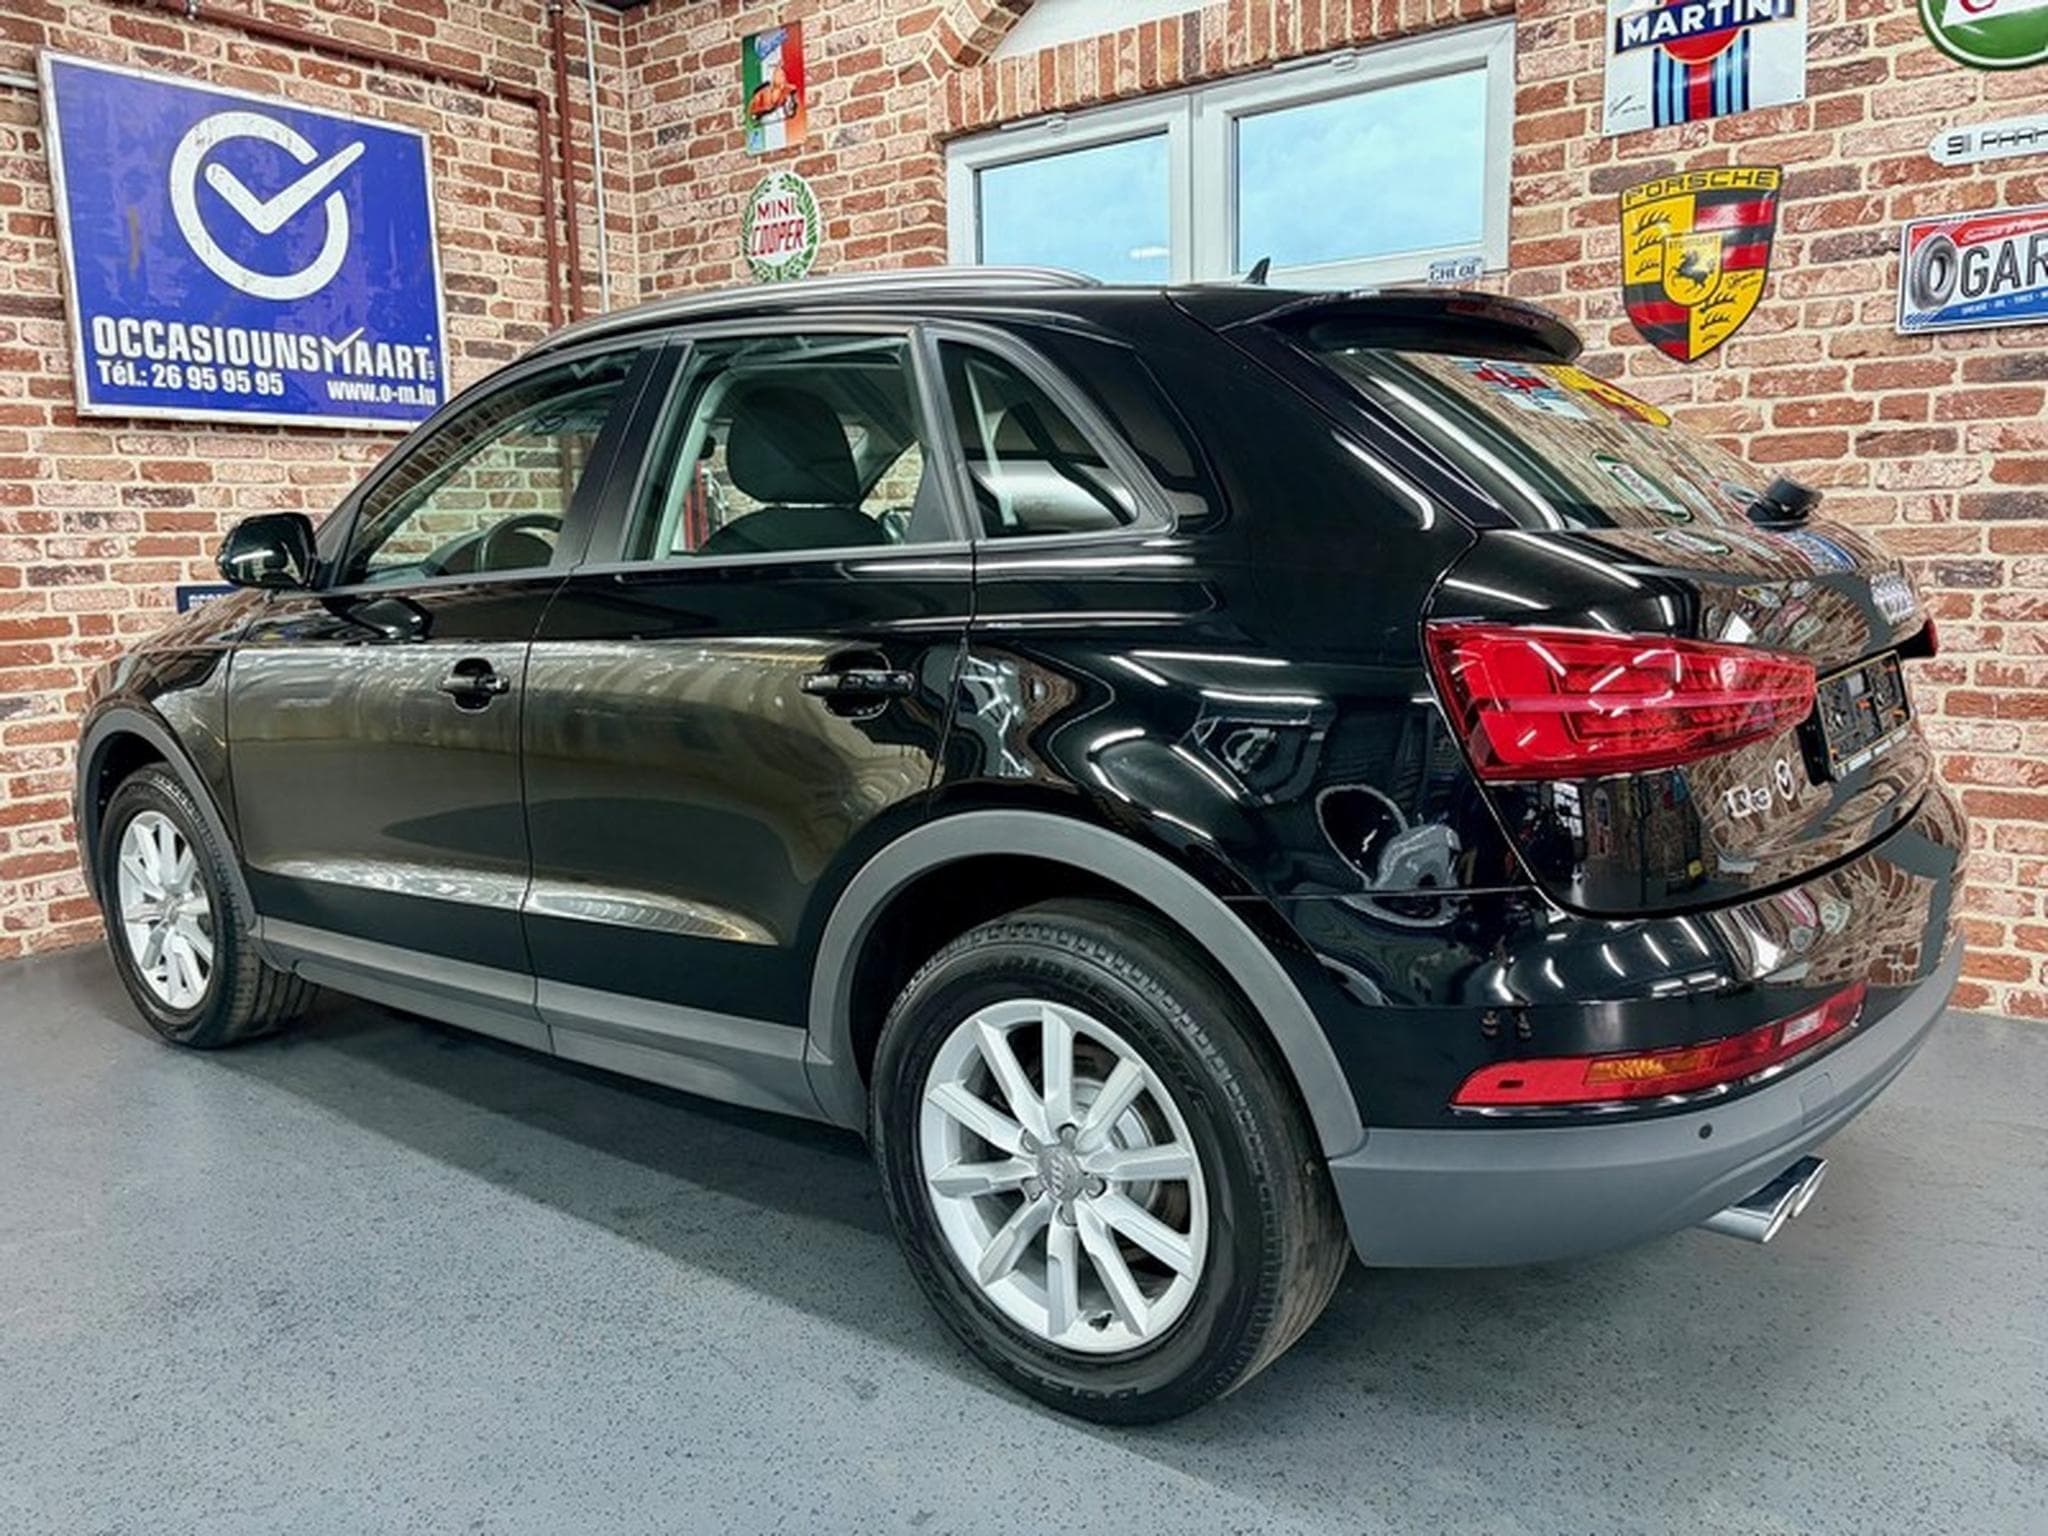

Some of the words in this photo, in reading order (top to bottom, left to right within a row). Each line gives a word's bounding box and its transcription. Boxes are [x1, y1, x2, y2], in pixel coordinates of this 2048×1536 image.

[1622, 0, 1787, 47] MARTINI
[1625, 170, 1775, 206] PORSCHE
[757, 196, 796, 221] MINI
[752, 218, 804, 257] COOPER
[92, 315, 430, 381] OCCASIOUNSMAART
[151, 362, 183, 389] 26
[186, 365, 218, 391] 95
[220, 368, 251, 394] 95
[254, 370, 285, 396] 95
[326, 379, 437, 406] www.o-m.lu
